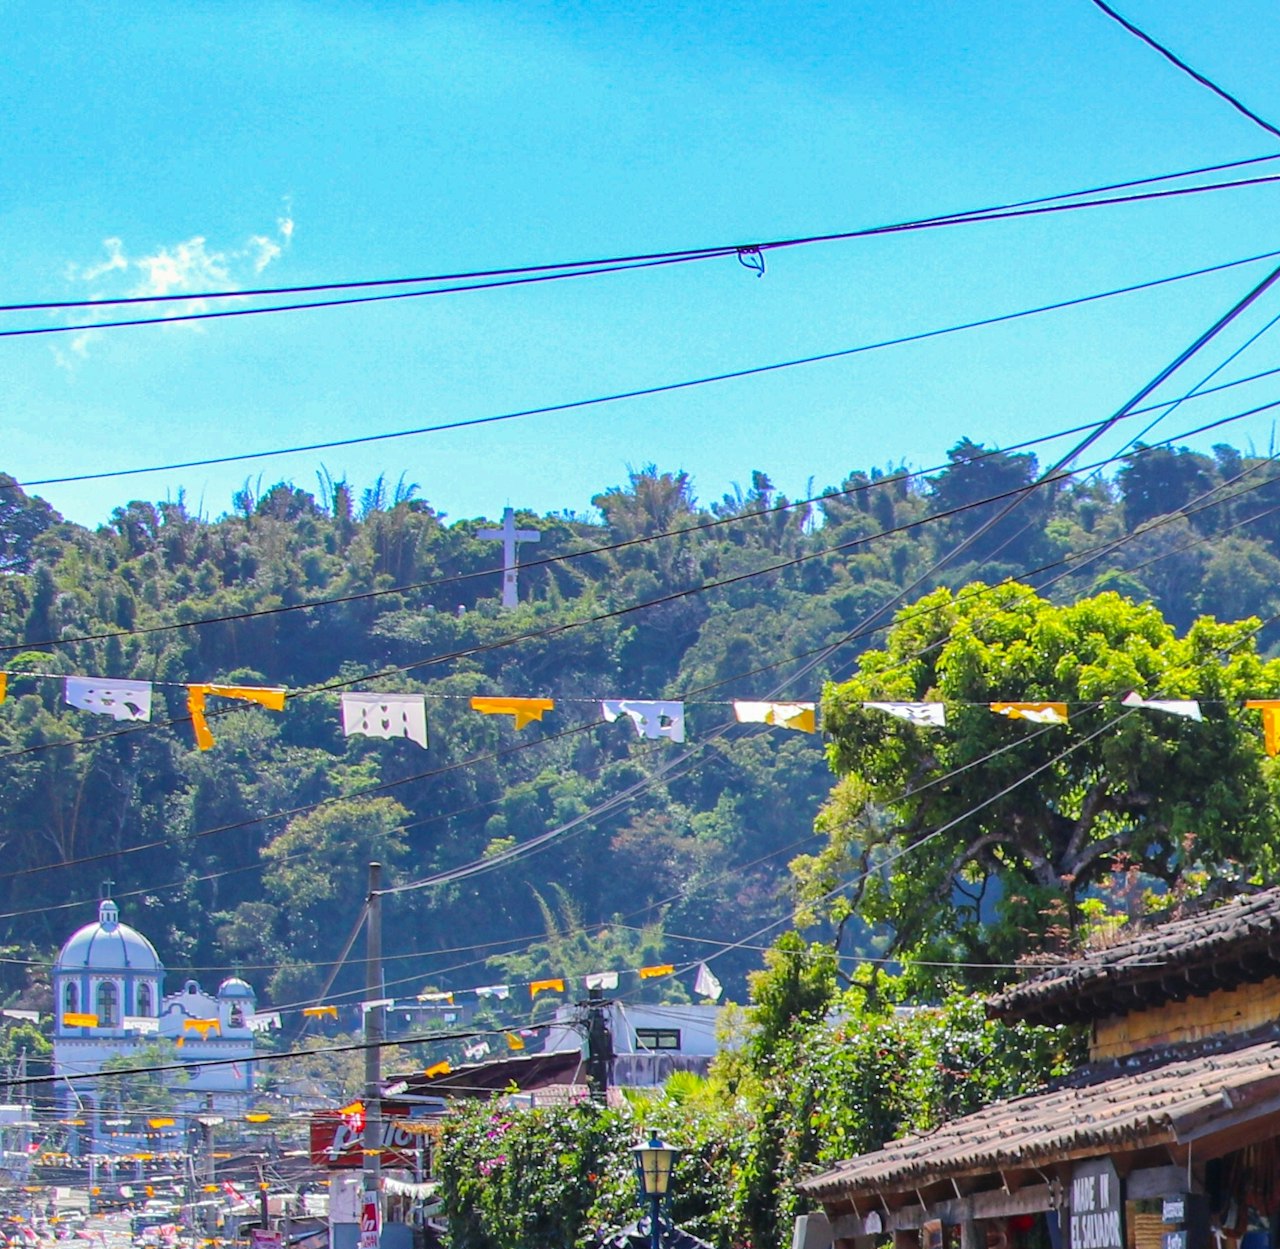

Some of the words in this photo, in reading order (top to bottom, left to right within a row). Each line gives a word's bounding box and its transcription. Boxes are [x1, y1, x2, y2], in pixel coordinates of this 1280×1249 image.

[1073, 1176, 1095, 1213] MADE
[1100, 1173, 1109, 1209] IN
[1071, 1215, 1081, 1249] EL
[1082, 1210, 1121, 1249] SALVADOR
